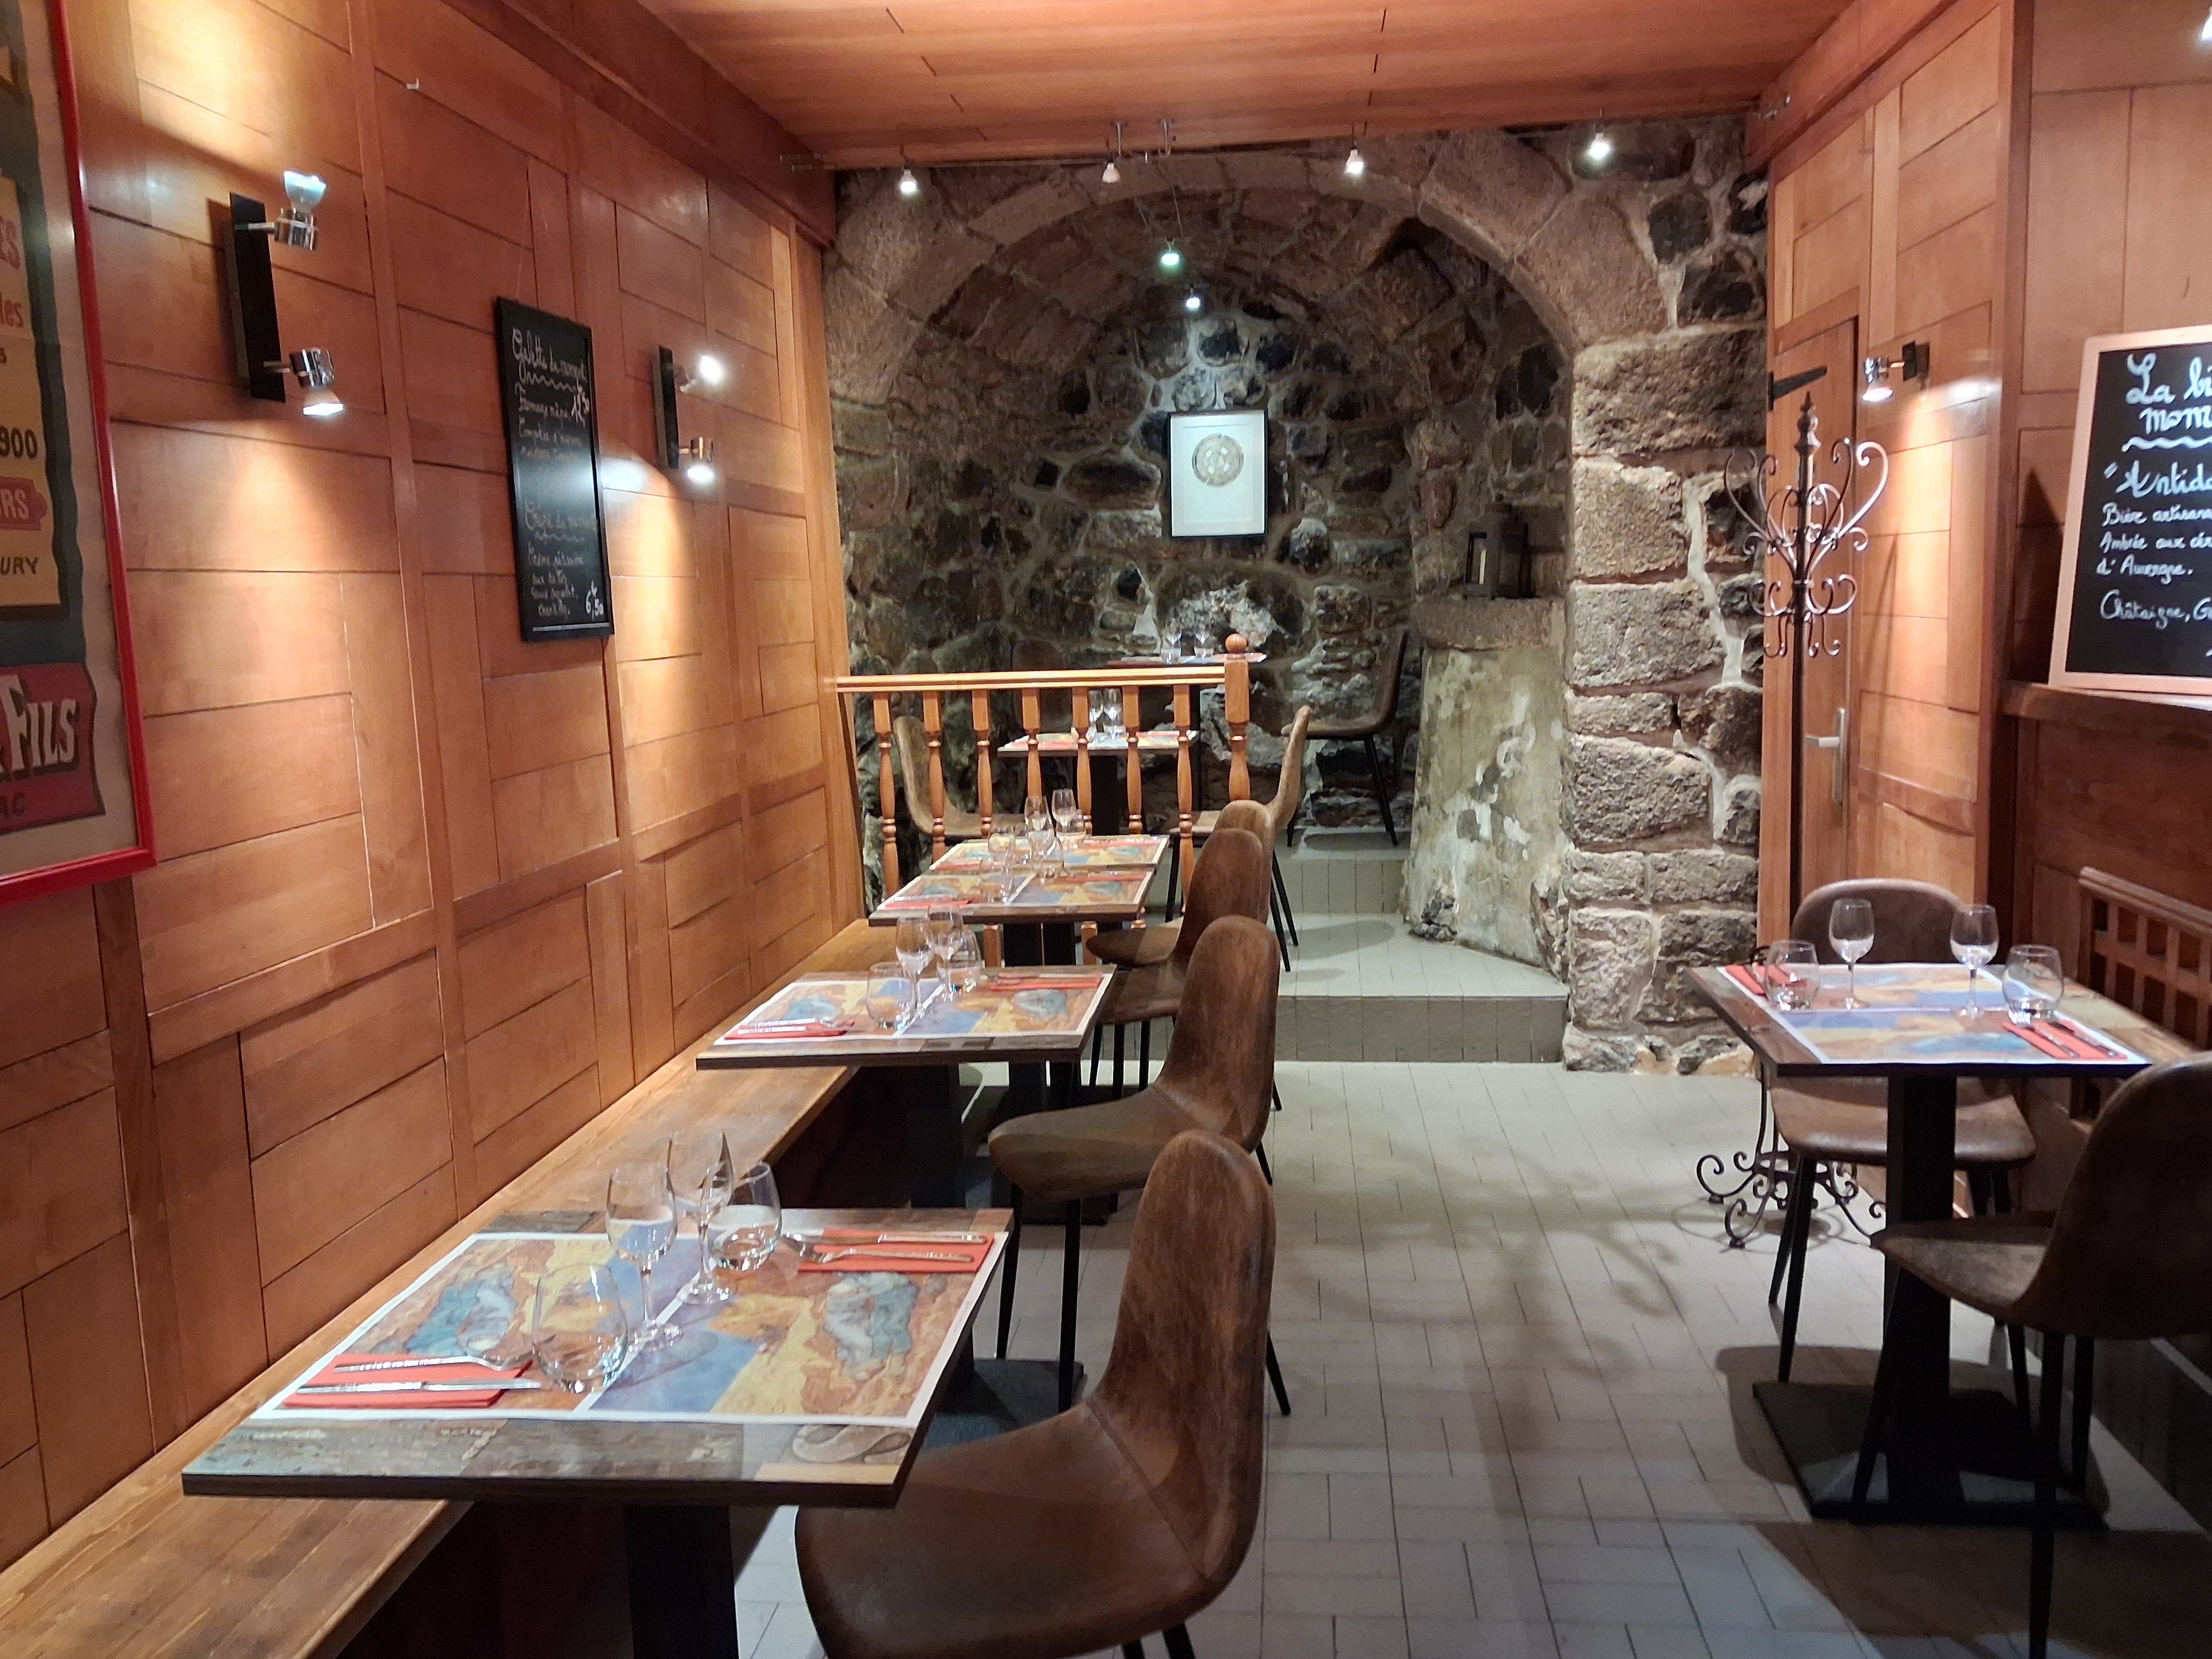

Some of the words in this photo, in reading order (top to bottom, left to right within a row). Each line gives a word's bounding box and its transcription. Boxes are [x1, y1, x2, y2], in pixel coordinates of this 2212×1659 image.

[2125, 352, 2176, 405] La
[2101, 501, 2147, 526] Bière
[2100, 531, 2148, 553] Ambrée
[2156, 537, 2186, 549] aux
